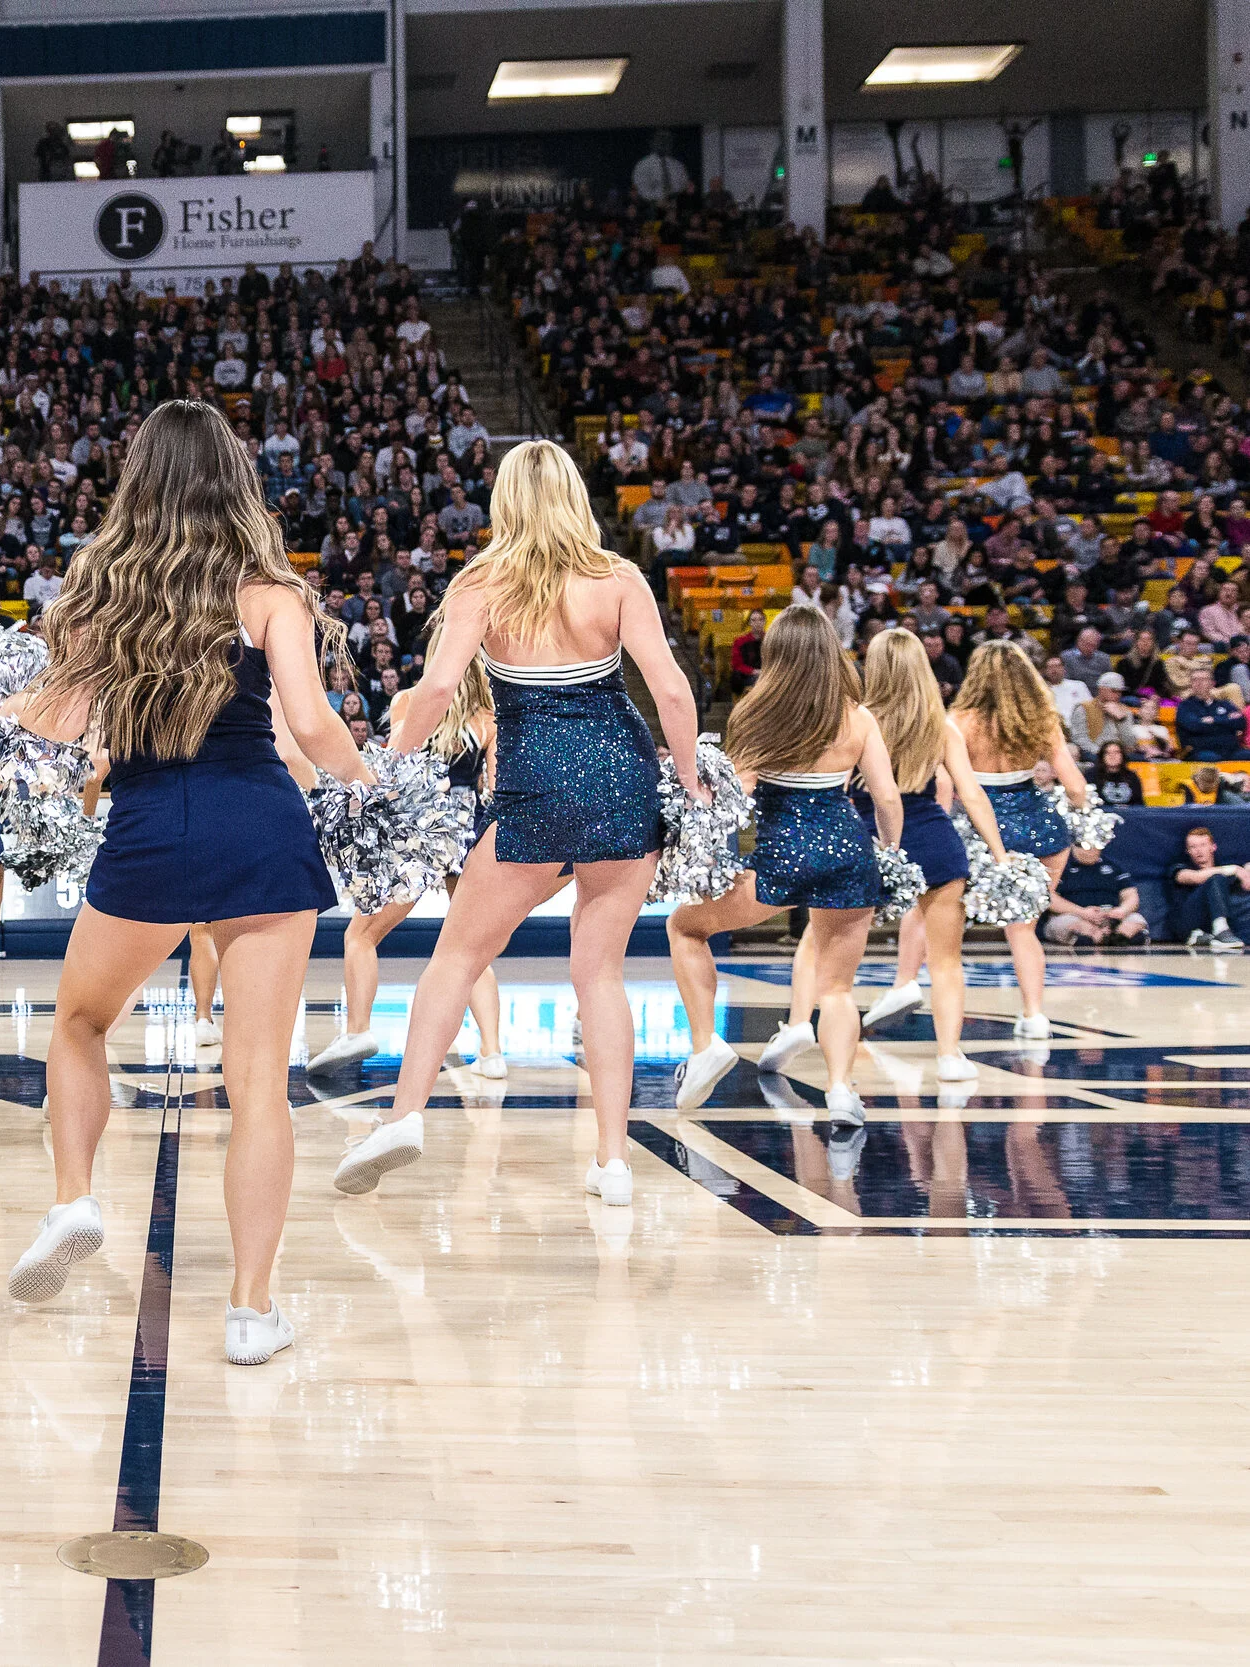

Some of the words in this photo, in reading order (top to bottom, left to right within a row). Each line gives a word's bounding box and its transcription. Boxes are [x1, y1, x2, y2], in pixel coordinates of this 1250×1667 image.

[797, 126, 816, 143] M
[115, 205, 148, 249] F
[178, 196, 296, 233] Fisher
[174, 236, 215, 250] Home
[220, 234, 302, 250] Furnishings
